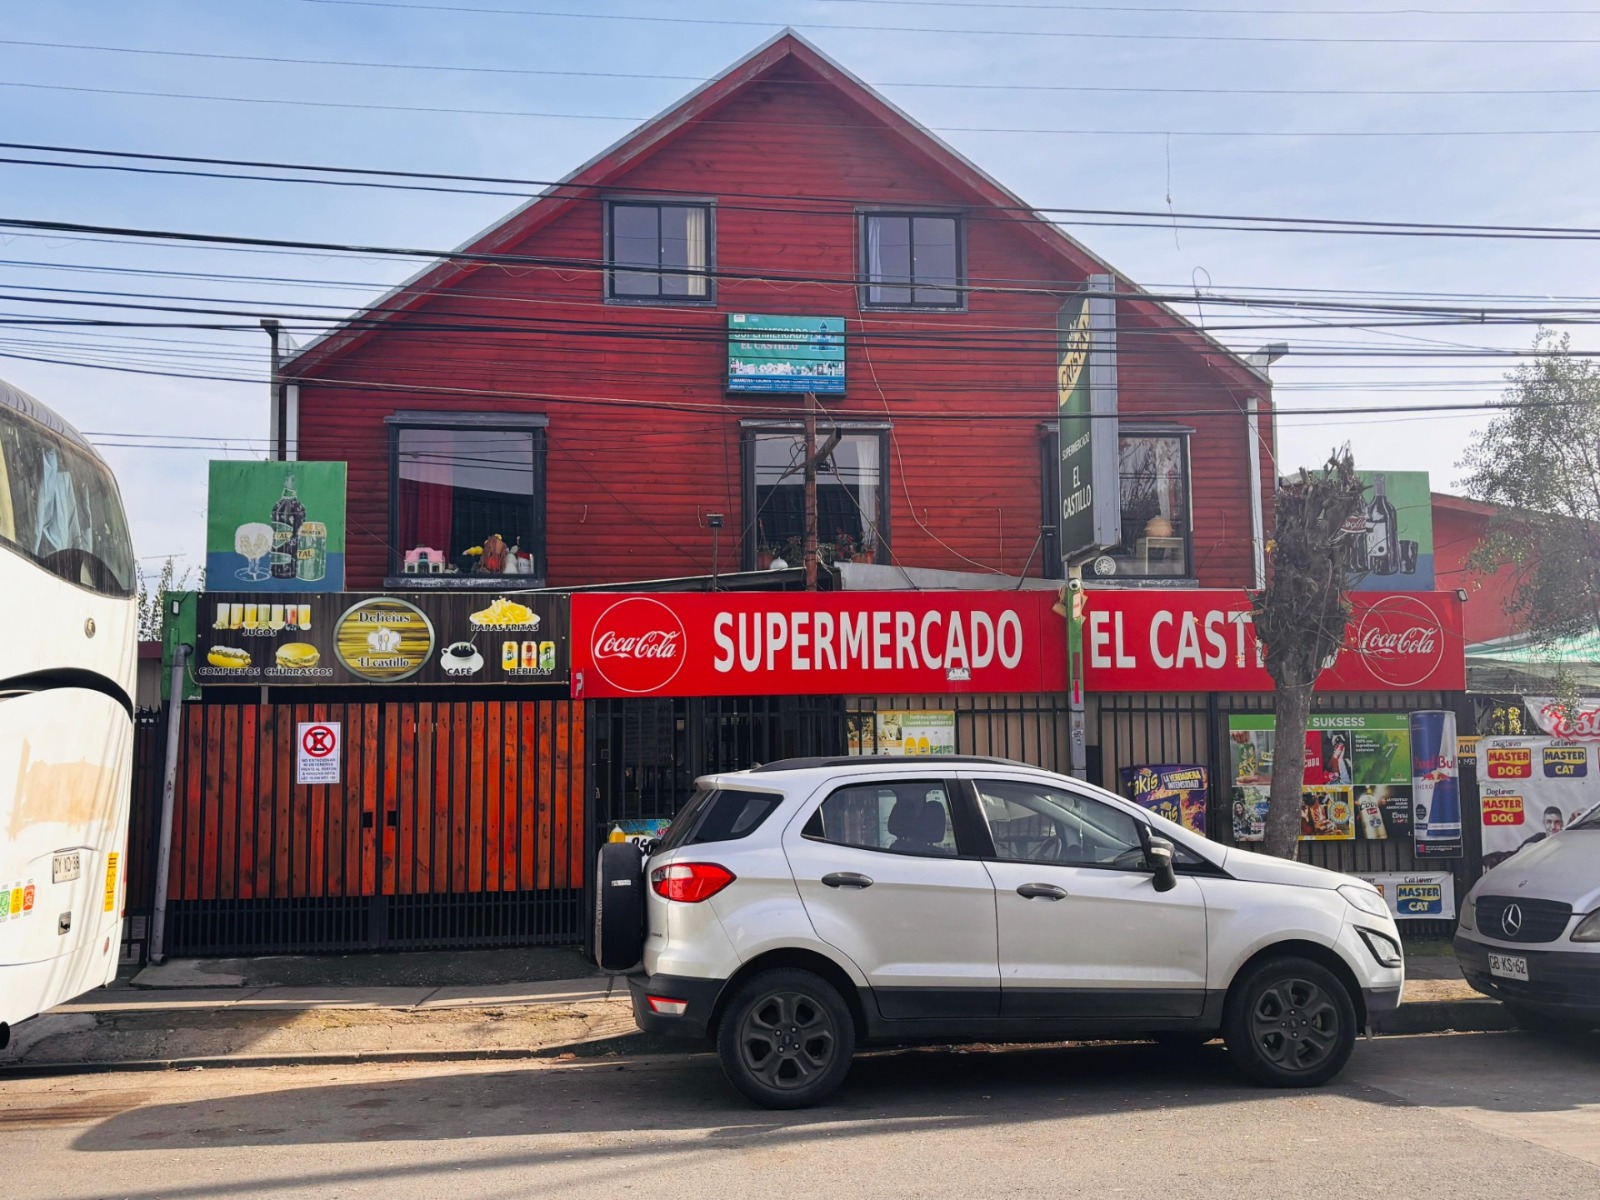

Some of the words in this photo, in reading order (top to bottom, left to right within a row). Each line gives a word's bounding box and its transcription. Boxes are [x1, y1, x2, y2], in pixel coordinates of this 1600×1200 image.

[1072, 465, 1081, 489] EL
[1063, 484, 1092, 520] CASTILLO
[358, 612, 411, 623] Delicias
[242, 628, 278, 637] JUGOS
[470, 623, 503, 632] PAPAS
[504, 623, 540, 632] FRITAS
[594, 630, 682, 659] Coca-Cola
[713, 609, 1023, 673] SUPERMERCADO
[1089, 610, 1136, 669] EL
[1360, 626, 1437, 655] Coca-Cola
[372, 657, 410, 667] castillo
[198, 667, 261, 676] COMPLETOS
[263, 667, 334, 677] CHURRASCOS
[446, 667, 473, 676] CAFÉ
[508, 667, 552, 676] BEBIDAS
[1312, 717, 1366, 727] SUKSESS
[1459, 744, 1476, 754] AQU
[1414, 752, 1436, 769] Red
[1488, 752, 1529, 762] MASTER
[1544, 751, 1585, 761] MASTER
[1497, 766, 1522, 776] DOG
[1555, 765, 1575, 775] CAT
[1483, 799, 1522, 809] MASTER
[1491, 813, 1514, 823] DOG
[1398, 887, 1440, 897] MASTER
[1408, 902, 1430, 911] CAT
